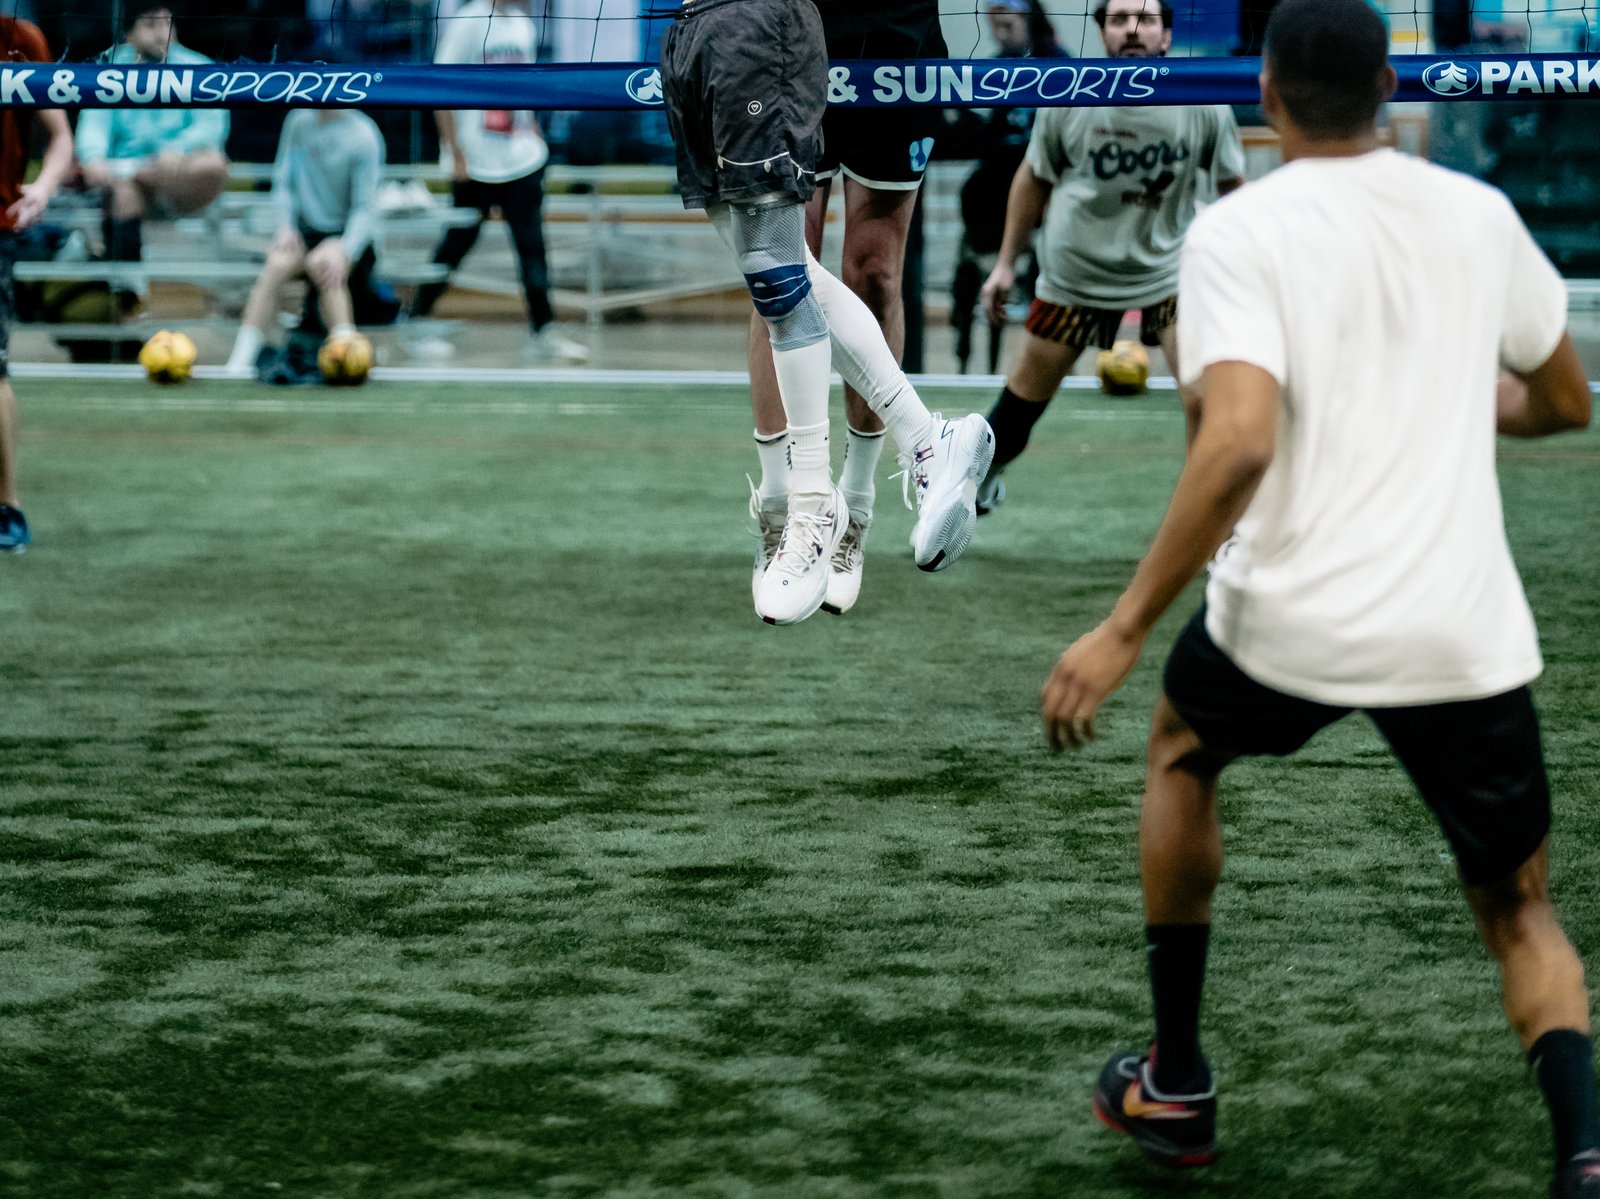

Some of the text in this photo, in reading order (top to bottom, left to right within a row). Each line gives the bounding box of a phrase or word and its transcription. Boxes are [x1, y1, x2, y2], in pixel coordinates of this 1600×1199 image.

[47, 69, 82, 104] &
[94, 69, 194, 104] SUN
[872, 65, 974, 102] SUN
